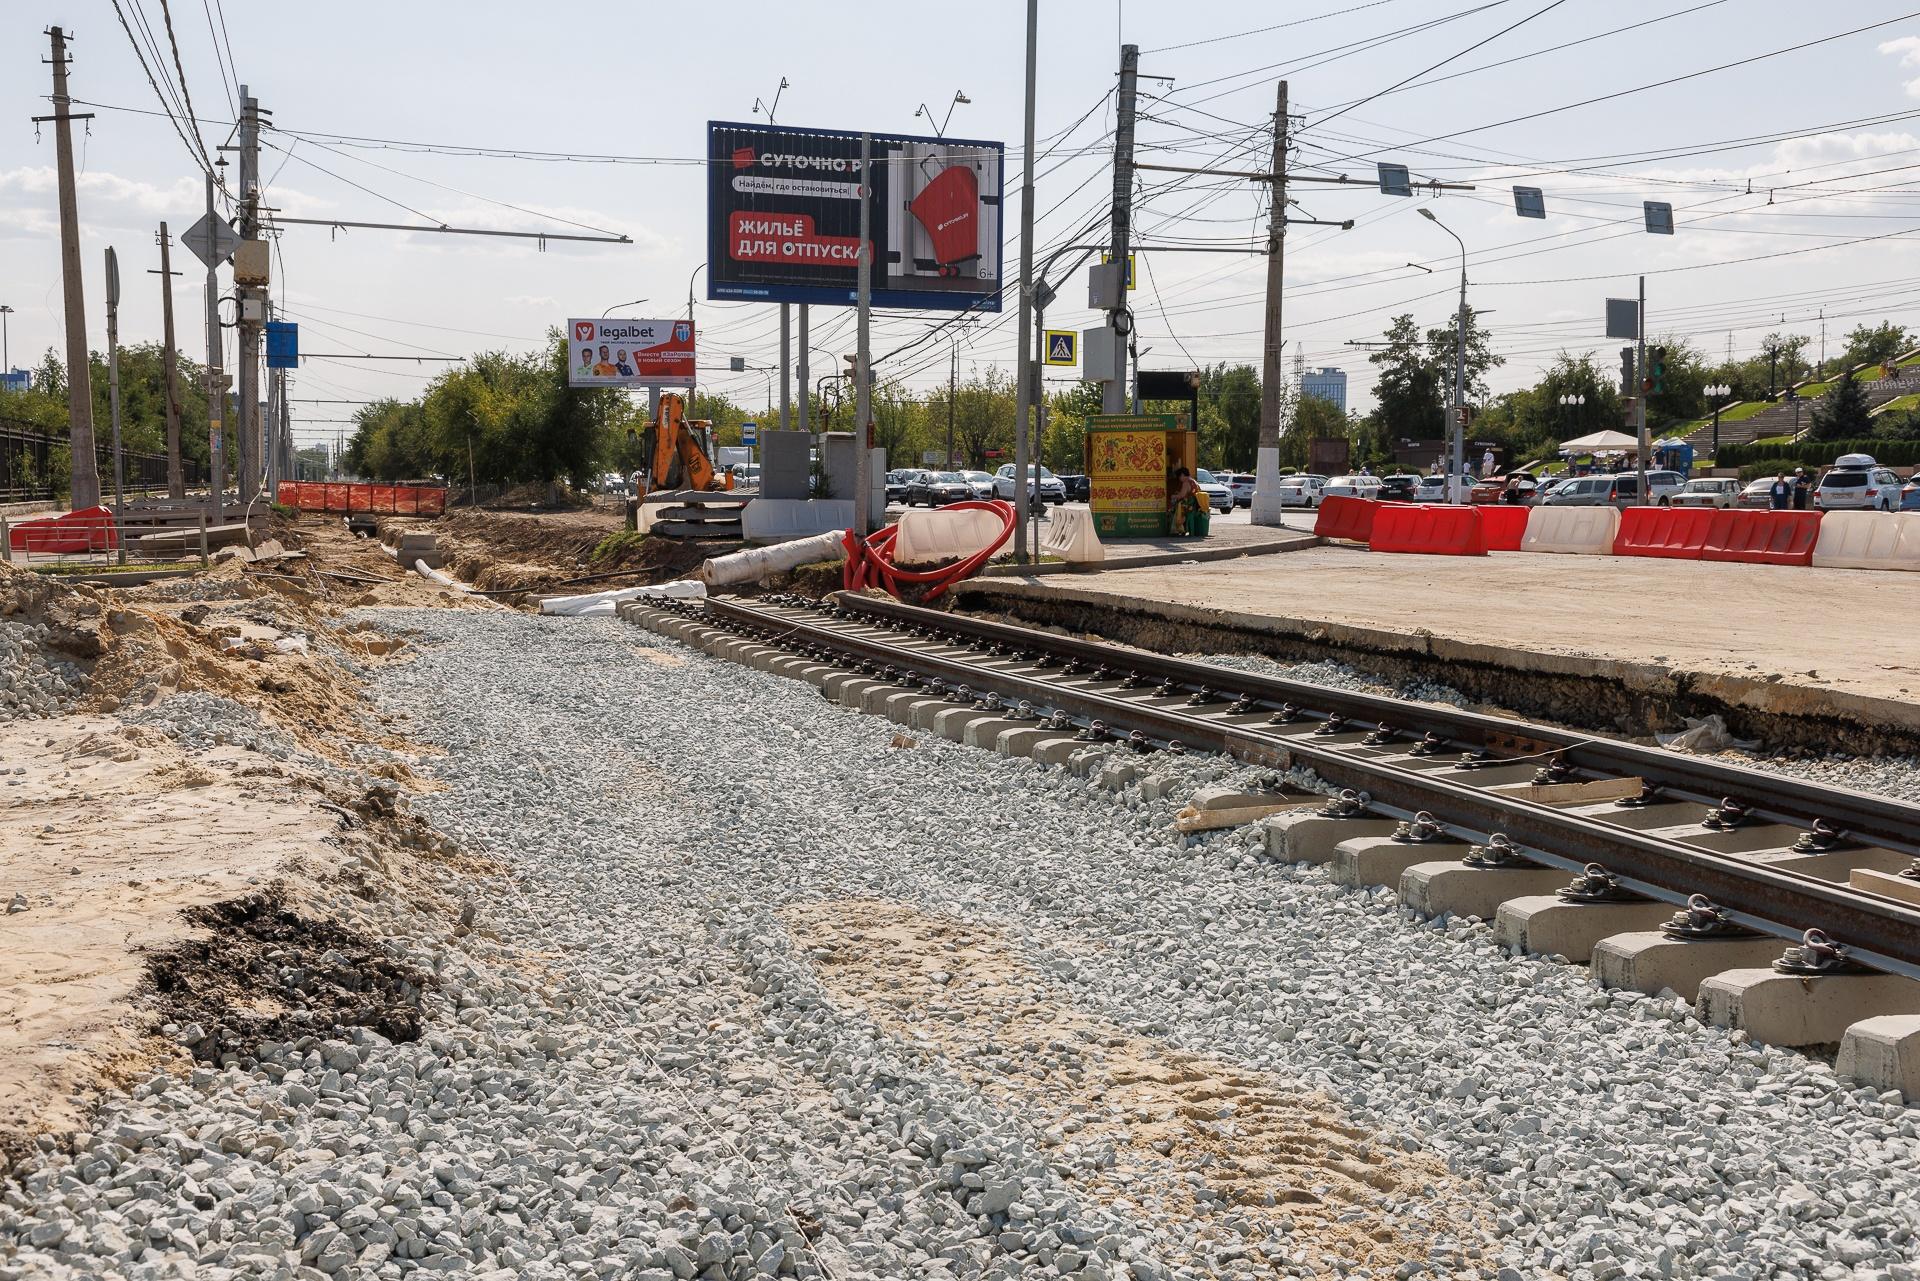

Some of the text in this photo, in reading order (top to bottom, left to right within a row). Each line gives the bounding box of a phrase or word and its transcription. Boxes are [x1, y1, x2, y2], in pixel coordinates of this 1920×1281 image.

[739, 180, 774, 190] Найдём,
[792, 185, 848, 195] остановиться
[738, 220, 804, 237] ЖИЛЬЁ
[738, 240, 777, 256] ДЛЯ
[980, 268, 994, 279] 6+
[600, 325, 655, 340] legalbet
